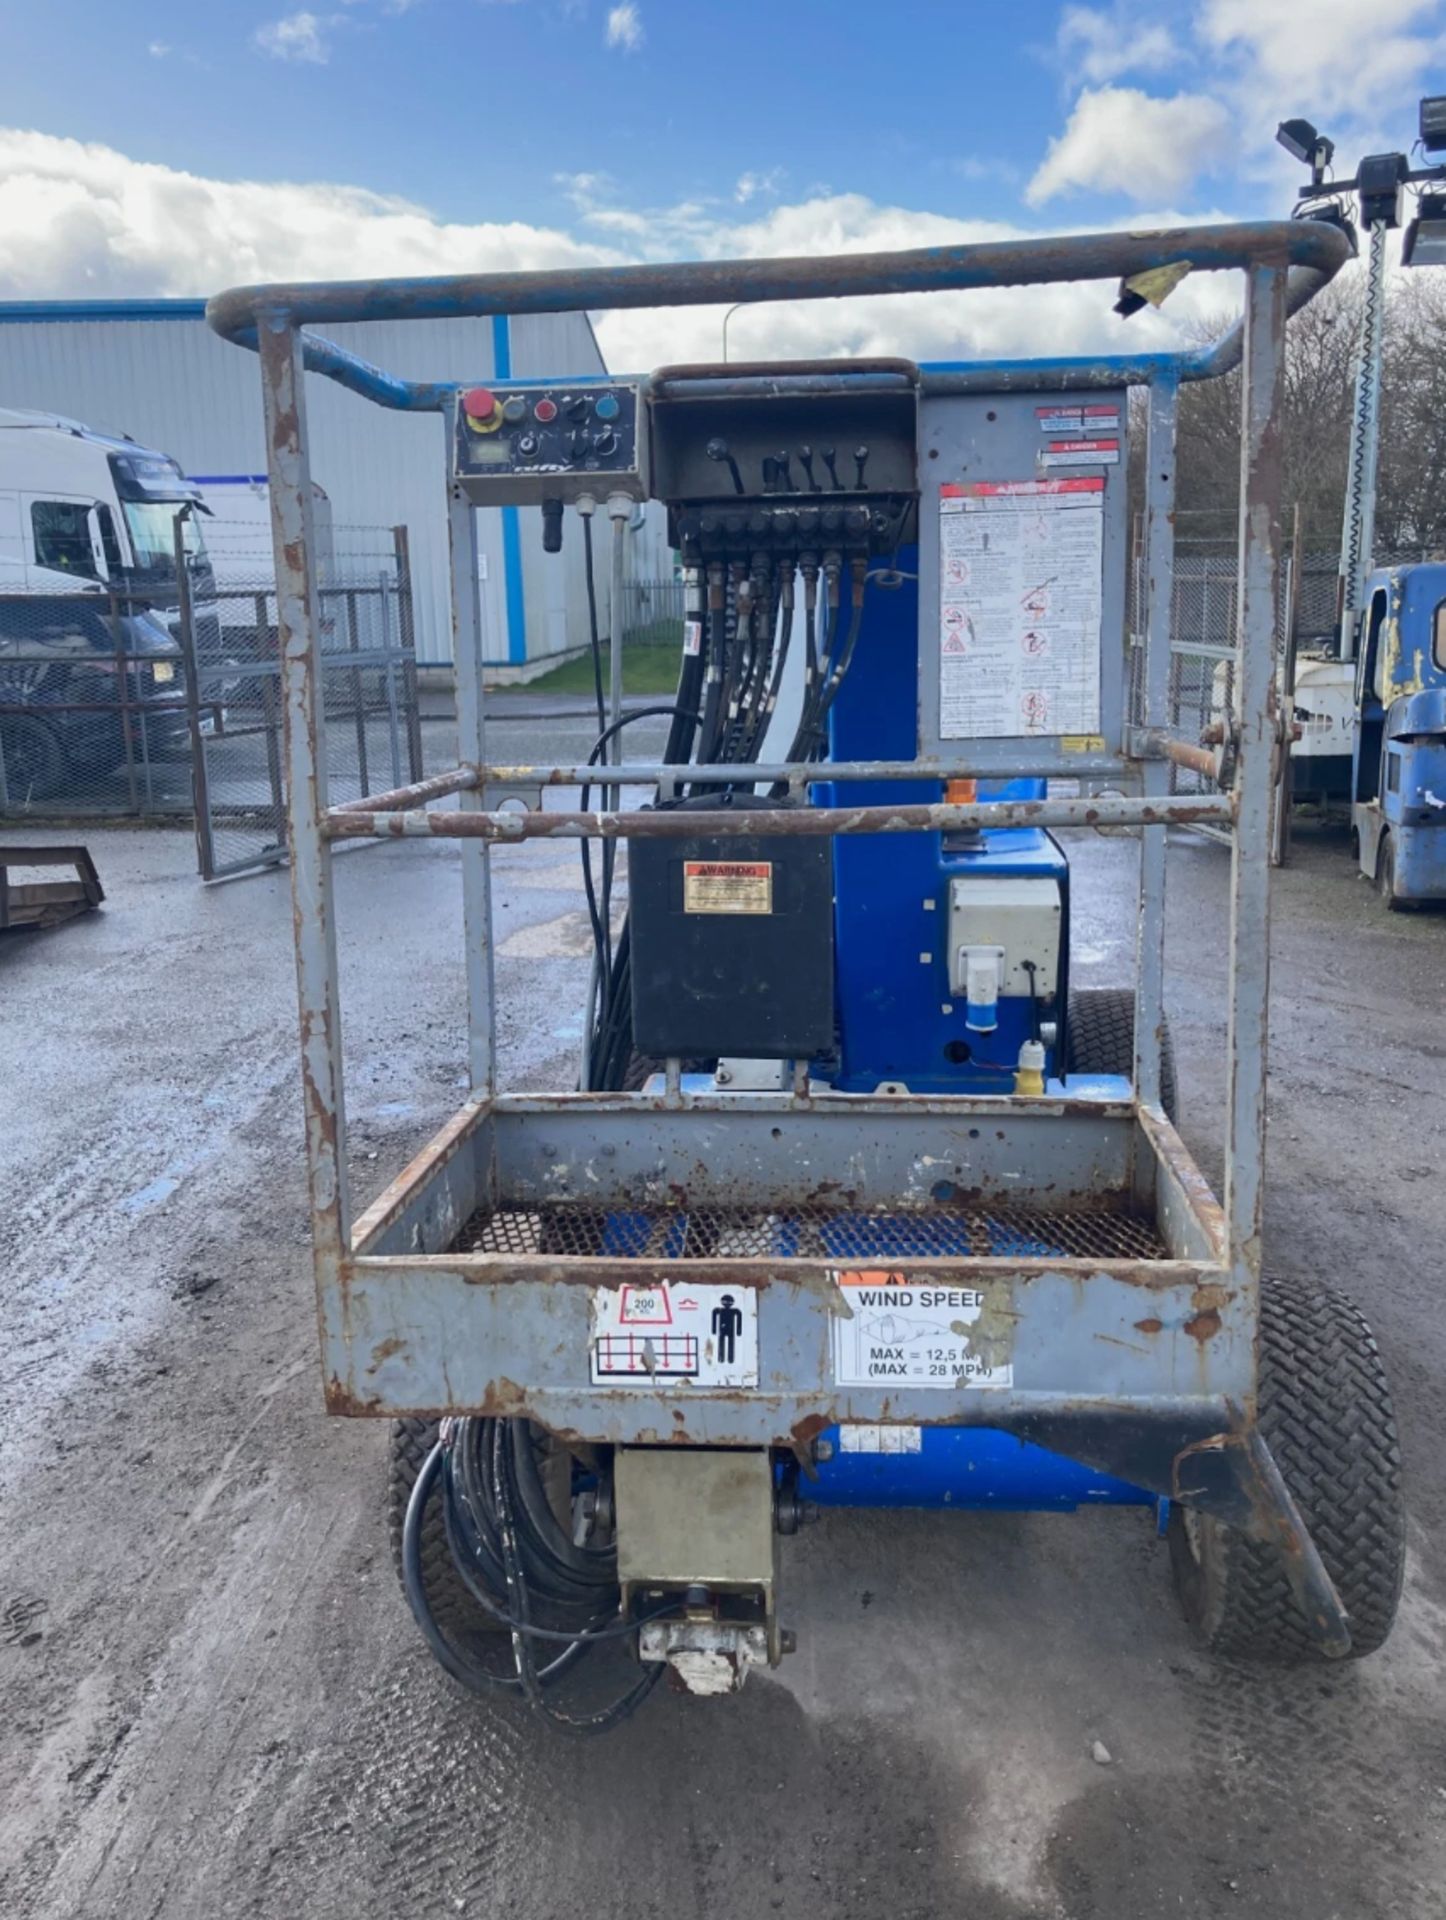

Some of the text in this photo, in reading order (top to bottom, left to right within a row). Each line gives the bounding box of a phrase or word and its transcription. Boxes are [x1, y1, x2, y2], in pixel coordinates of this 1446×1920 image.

[705, 864, 757, 876] WARNING
[634, 1299, 654, 1309] 200
[858, 1291, 913, 1306] WIND
[870, 1348, 904, 1360] MAX
[926, 1349, 957, 1363] 12,5
[868, 1364, 908, 1378] (MAX
[928, 1364, 947, 1376] 28
